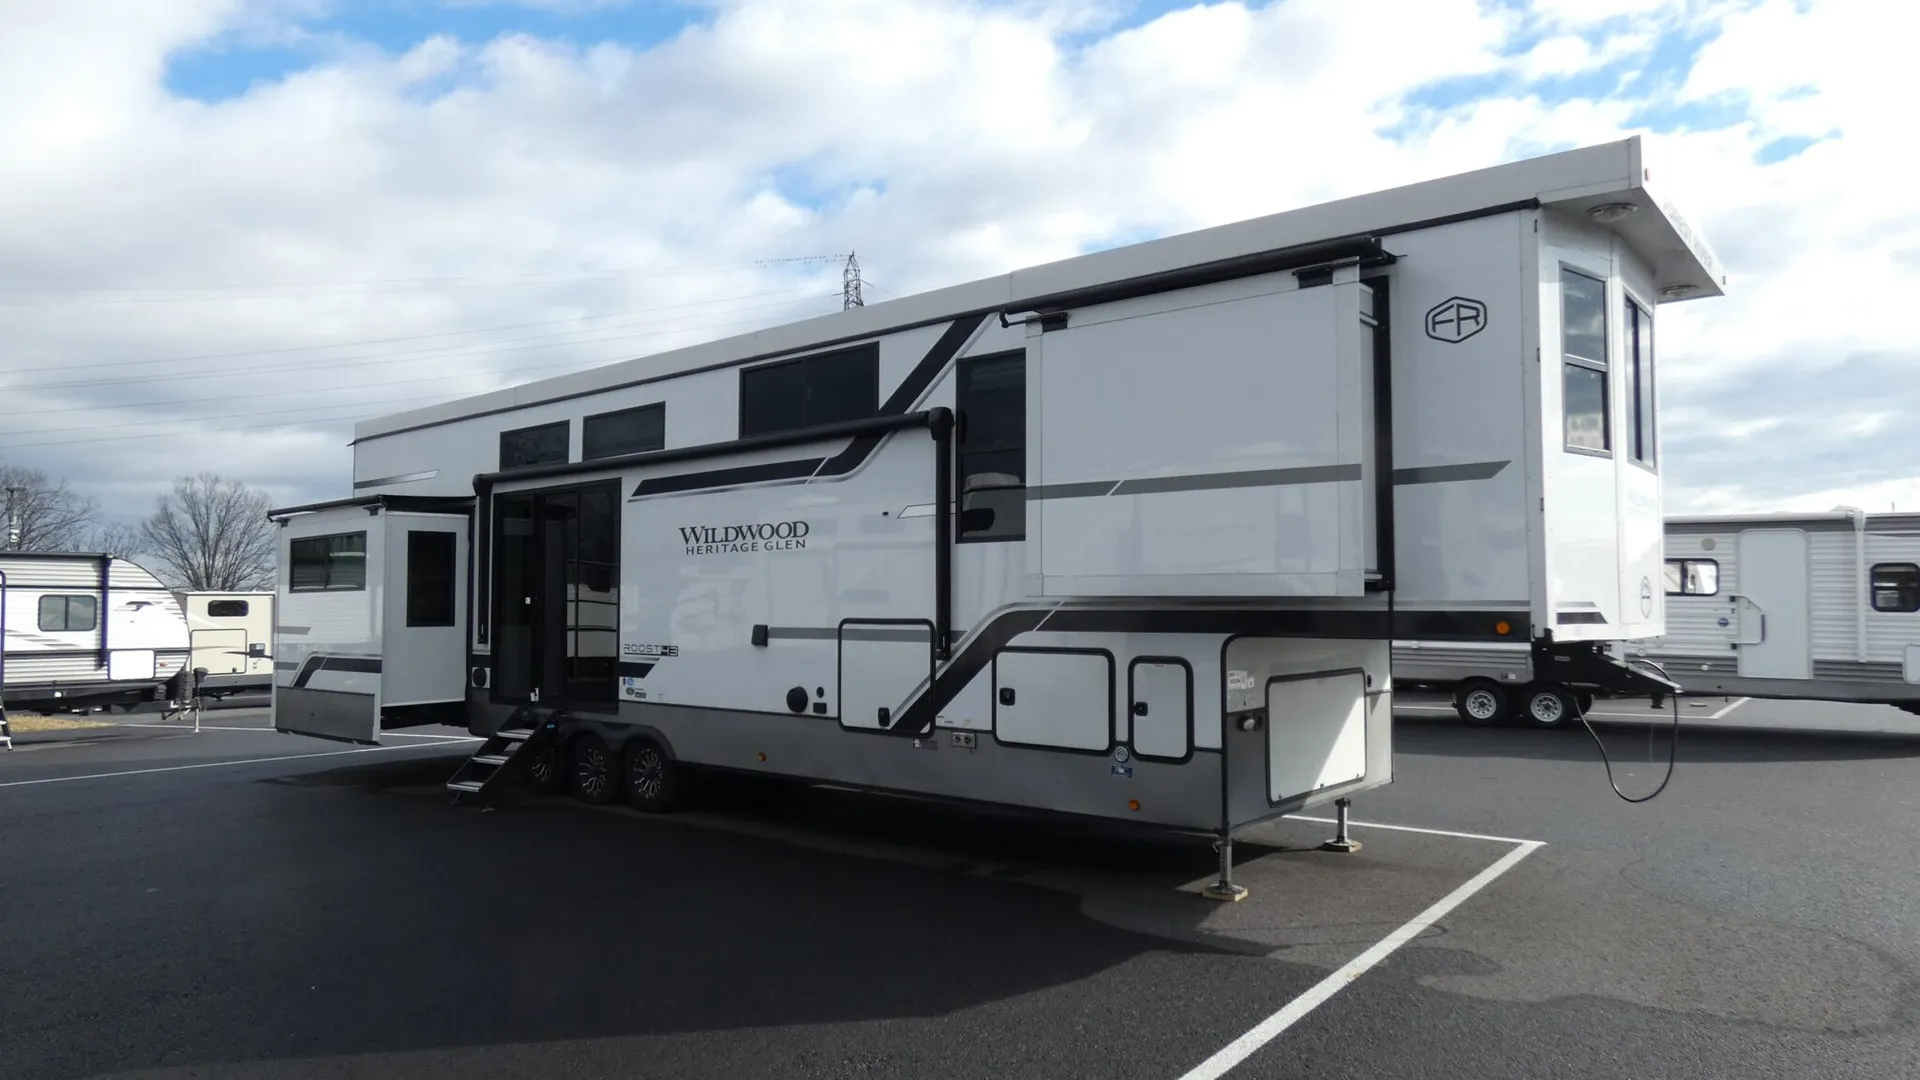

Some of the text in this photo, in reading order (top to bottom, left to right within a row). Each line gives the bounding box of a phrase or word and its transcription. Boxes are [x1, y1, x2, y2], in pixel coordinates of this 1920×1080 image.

[678, 520, 810, 545] WILDWOOD
[686, 539, 806, 555] HERITAGE GLEN
